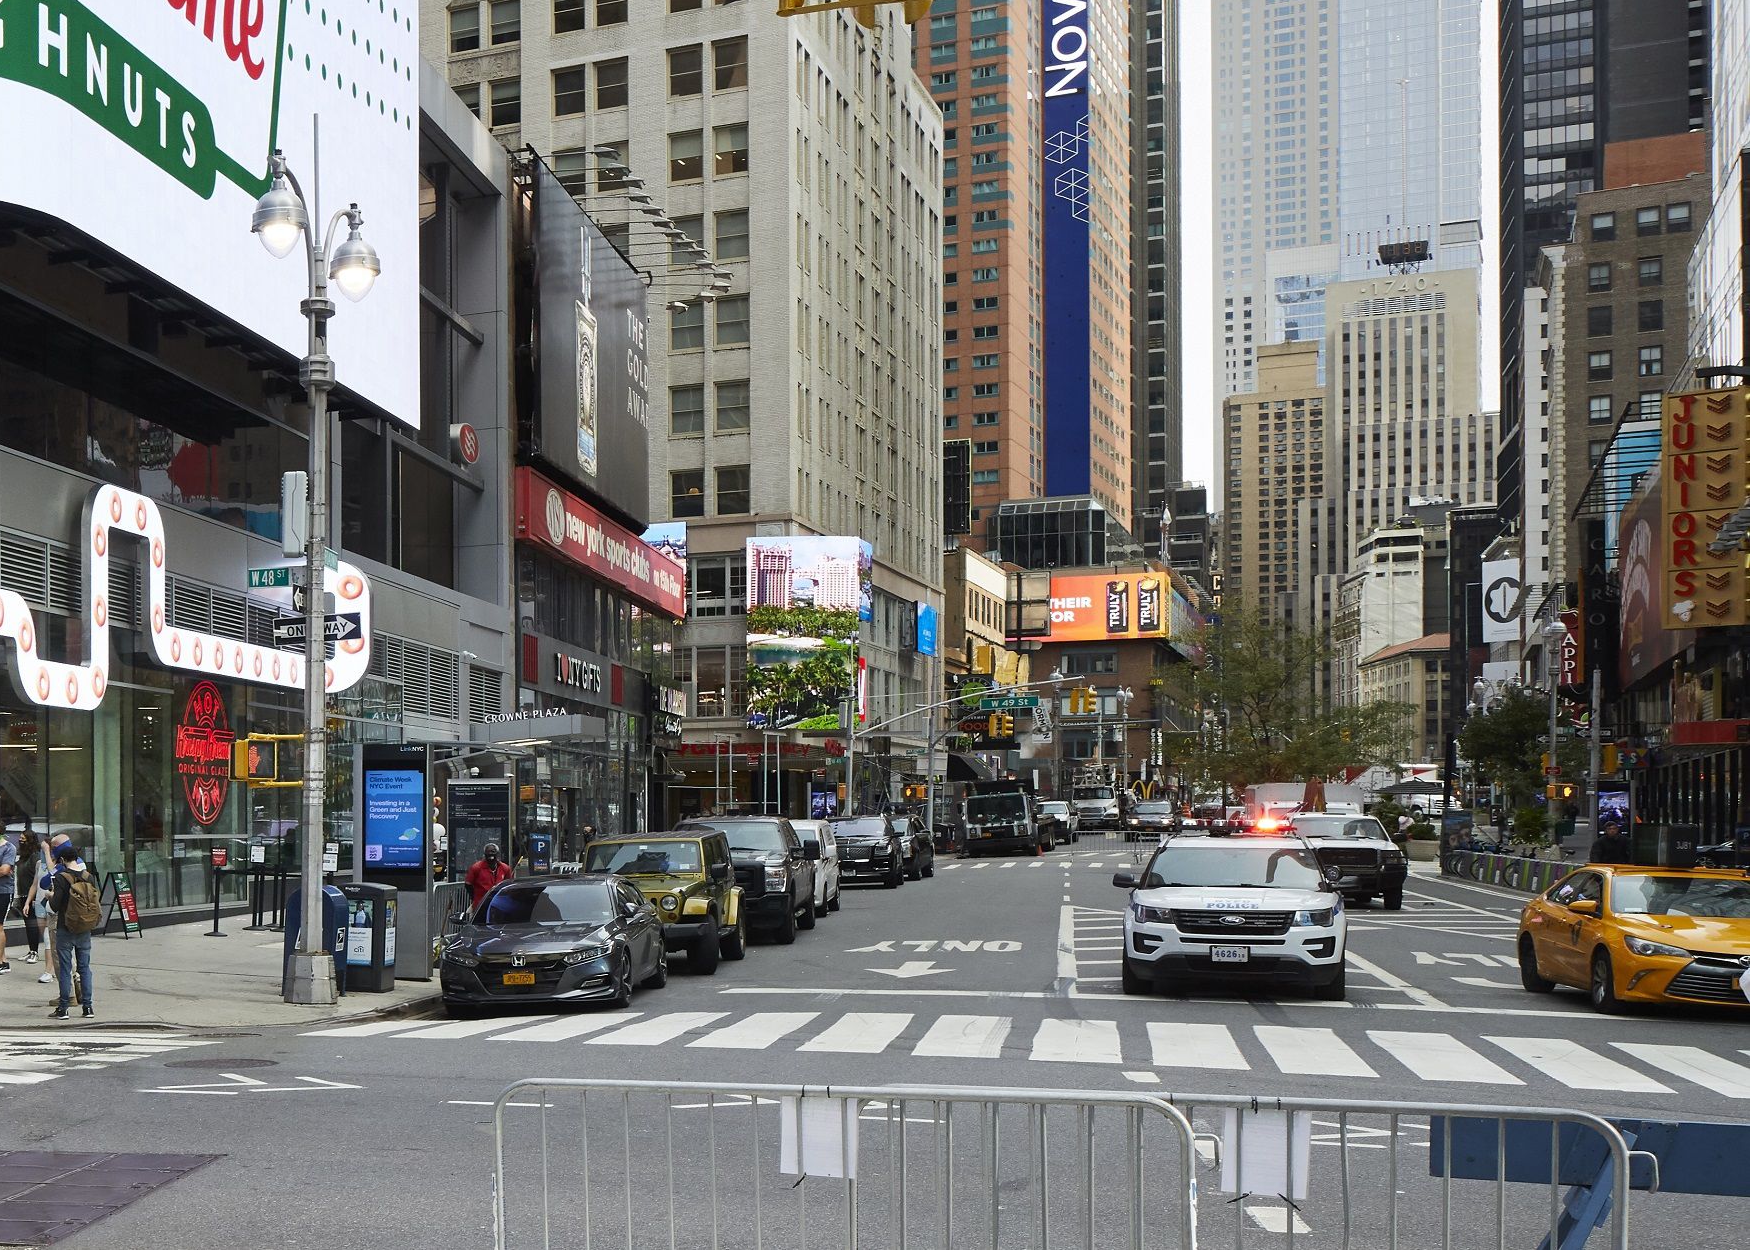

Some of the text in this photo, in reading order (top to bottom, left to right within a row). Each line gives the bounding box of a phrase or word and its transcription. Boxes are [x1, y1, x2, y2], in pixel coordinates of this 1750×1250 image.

[1372, 277, 1427, 295] 1740
[627, 308, 643, 347] THE
[1672, 395, 1698, 597] JUNIORS
[566, 512, 585, 546] new
[586, 524, 605, 557] york
[606, 536, 631, 572] sports
[631, 547, 650, 583] clubs
[669, 574, 681, 598] Floor
[251, 570, 286, 586] W 48 ST
[1050, 611, 1075, 622] OR
[1109, 593, 1120, 627] TRULY
[1140, 590, 1151, 626] TRULY
[287, 626, 306, 637] ON
[581, 661, 601, 693] GIFTS
[194, 692, 219, 721] HOT
[1018, 698, 1029, 706] St
[485, 707, 567, 724] CROWNE PLAZA
[207, 728, 234, 761] Krem
[178, 763, 209, 775] ORIGINAL
[193, 780, 220, 814] NOW
[369, 813, 399, 821] Recovery
[537, 842, 545, 852] P
[354, 945, 365, 953] citi
[843, 940, 1023, 952] ONLY
[1214, 950, 1238, 958] 4626
